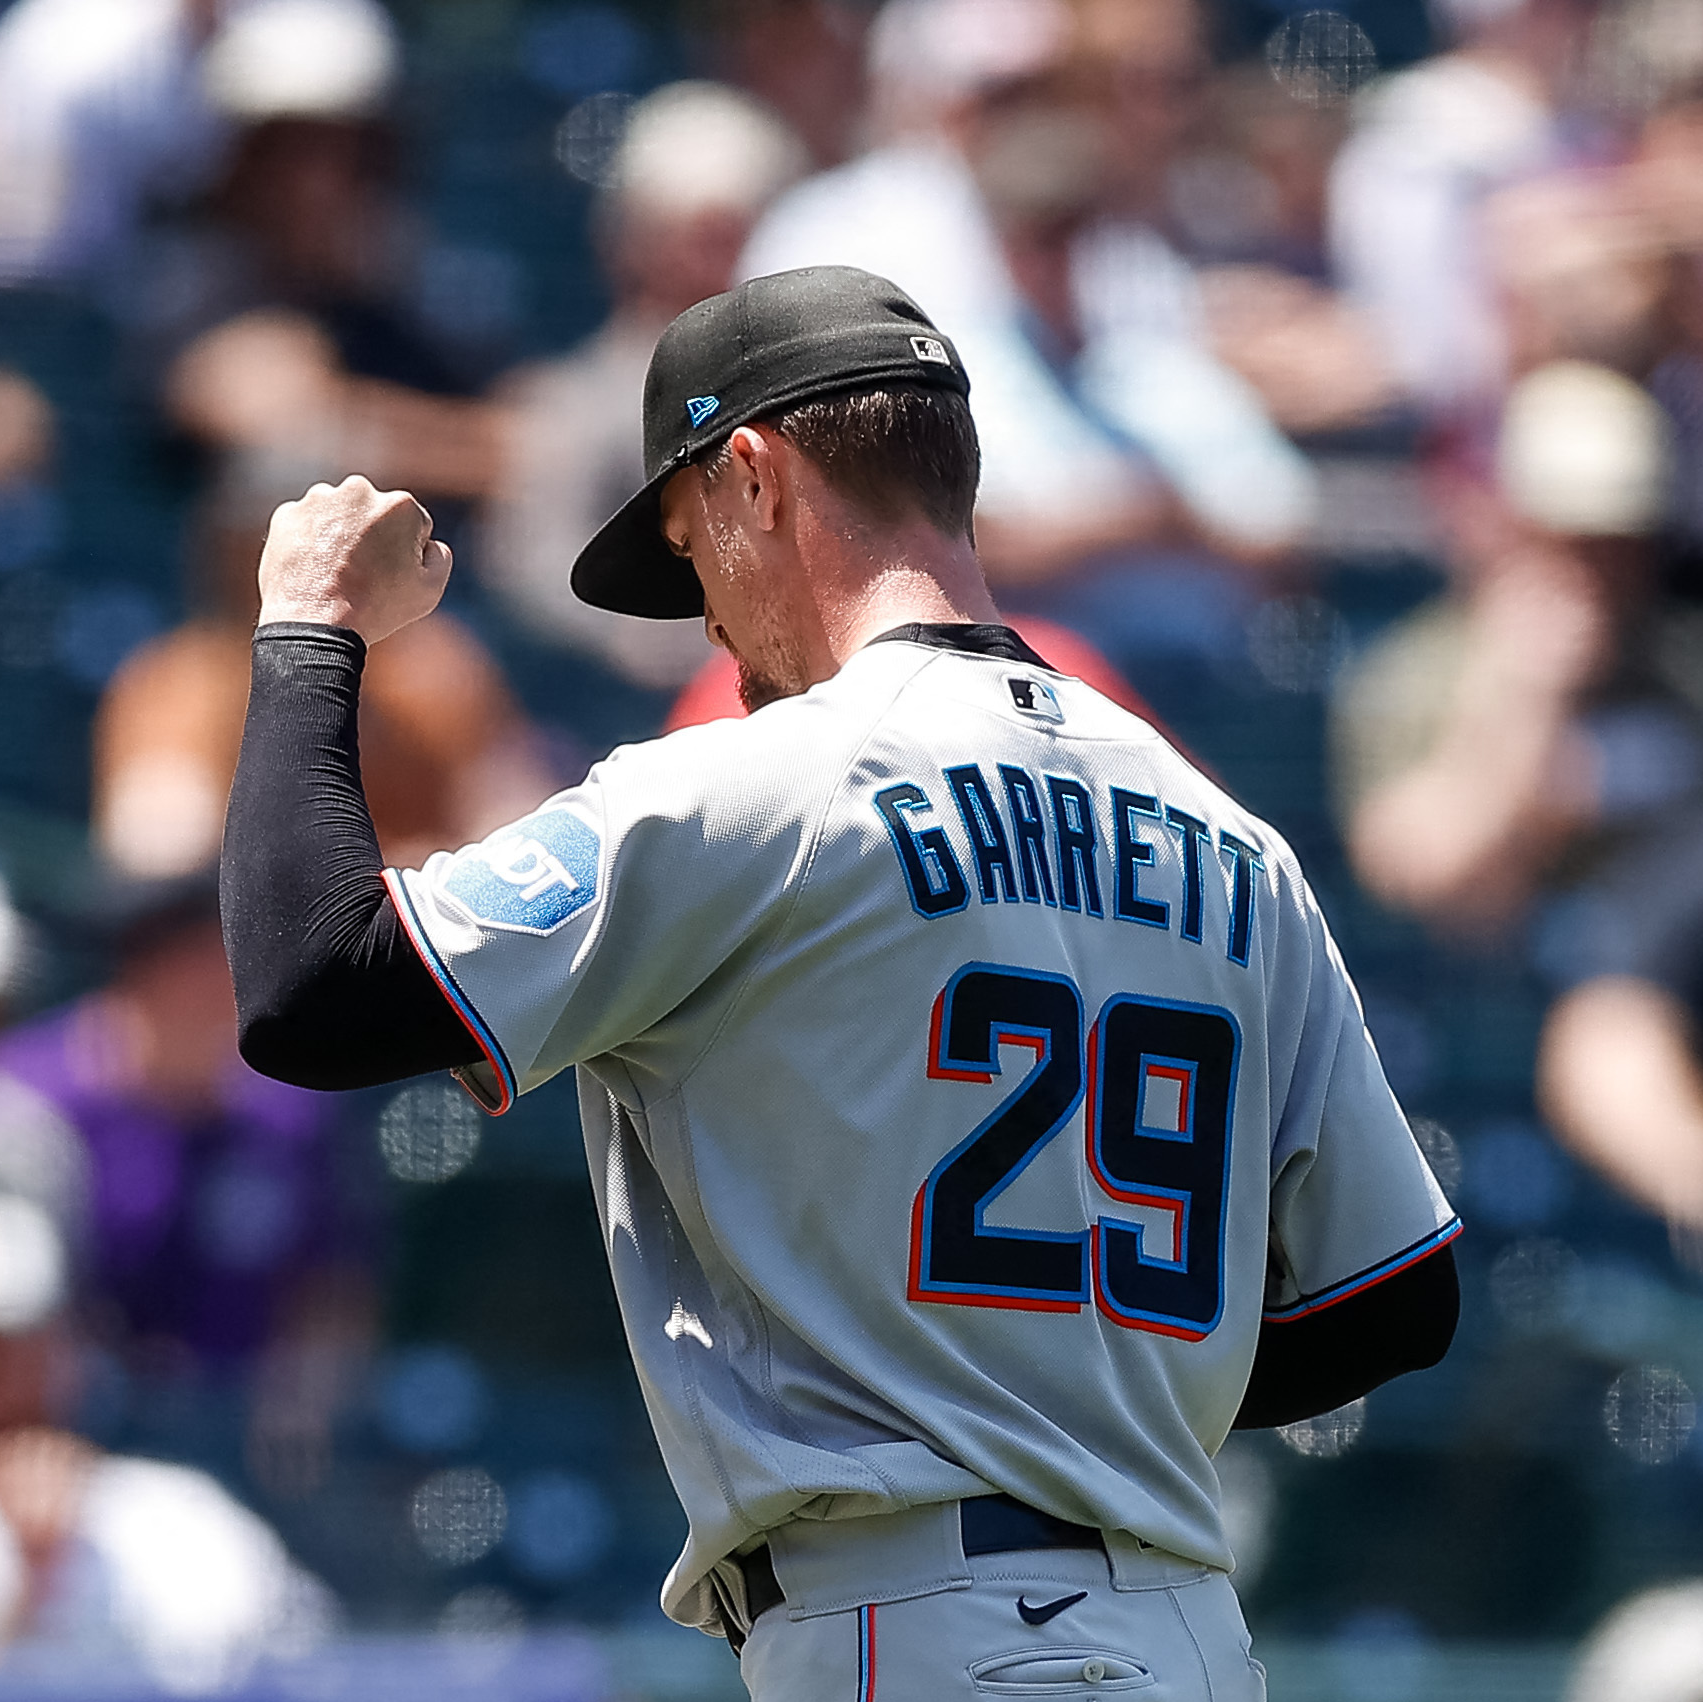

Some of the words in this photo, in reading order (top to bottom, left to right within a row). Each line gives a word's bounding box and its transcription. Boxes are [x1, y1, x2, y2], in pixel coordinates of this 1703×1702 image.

[482, 834, 580, 901] DT
[872, 763, 1266, 968] GARRETT
[907, 961, 1242, 1342] 29
